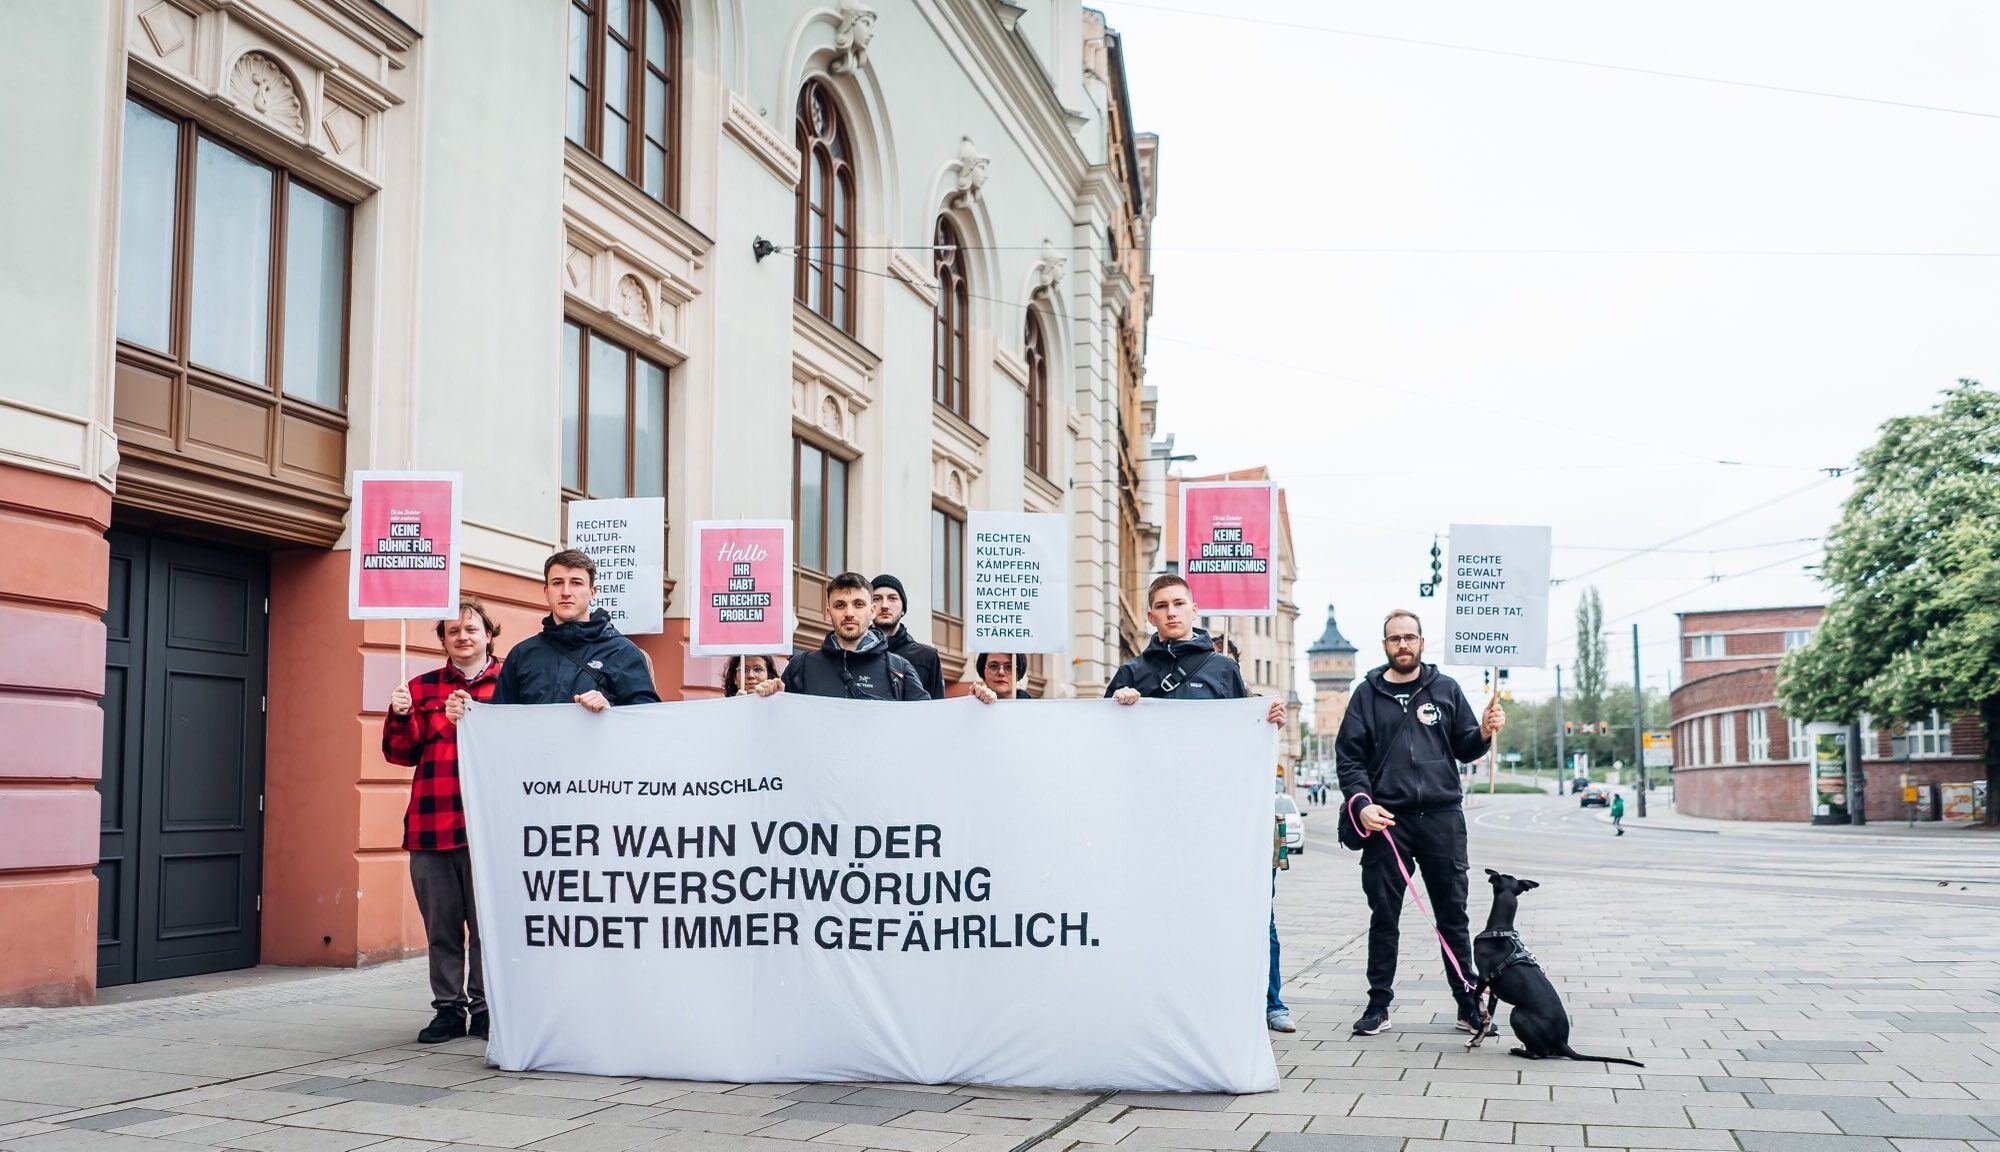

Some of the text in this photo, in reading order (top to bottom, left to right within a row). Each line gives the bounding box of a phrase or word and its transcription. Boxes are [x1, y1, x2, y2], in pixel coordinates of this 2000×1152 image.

[576, 520, 627, 530] RECHTEN
[391, 524, 420, 537] KEINE
[1214, 529, 1241, 542] KEINE
[576, 533, 622, 542] KULTUR-
[976, 533, 1031, 543] RECHTEN
[379, 538, 432, 552] BÜHNE FÜR
[1202, 543, 1253, 557] BÜHNE FÜR
[717, 541, 769, 562] Hallo
[976, 547, 1025, 556] KULTUR-
[364, 555, 446, 569] ANTISEMITISMUS
[976, 559, 1040, 570] KÄMPFERN
[1458, 555, 1502, 564] RECHTE
[734, 563, 750, 576] IHR
[1189, 560, 1266, 573] ANTISEMITISMUS
[616, 571, 634, 580] DIE
[1457, 568, 1503, 577] GEWALT
[976, 574, 991, 583] ZU
[595, 584, 626, 593] REME
[729, 579, 754, 591] HABT
[1457, 580, 1506, 590] BEGINNT
[976, 587, 1039, 597] MACHT DIE
[589, 598, 618, 607] CHTE
[713, 594, 770, 606] EIN RECHTES
[1456, 593, 1490, 602] NICHT
[976, 601, 1031, 611] EXTREME
[1456, 606, 1474, 615] BEI
[1477, 606, 1500, 615] DER
[720, 609, 763, 621] PROBLEM
[976, 614, 1023, 624] RECHTE
[976, 626, 1034, 638] STÄRKER.
[1455, 632, 1509, 641] SONDERN
[1455, 645, 1519, 655] BEIM WORT.
[523, 777, 783, 796] VOM ALUHUT ZUM ANSCHLAG
[523, 821, 942, 859] DER WAHN VON DER
[522, 862, 991, 906] WELTVERSCHWÖRUNG
[524, 910, 1100, 952] ENDET IMMER GEFÄHRLICH.
